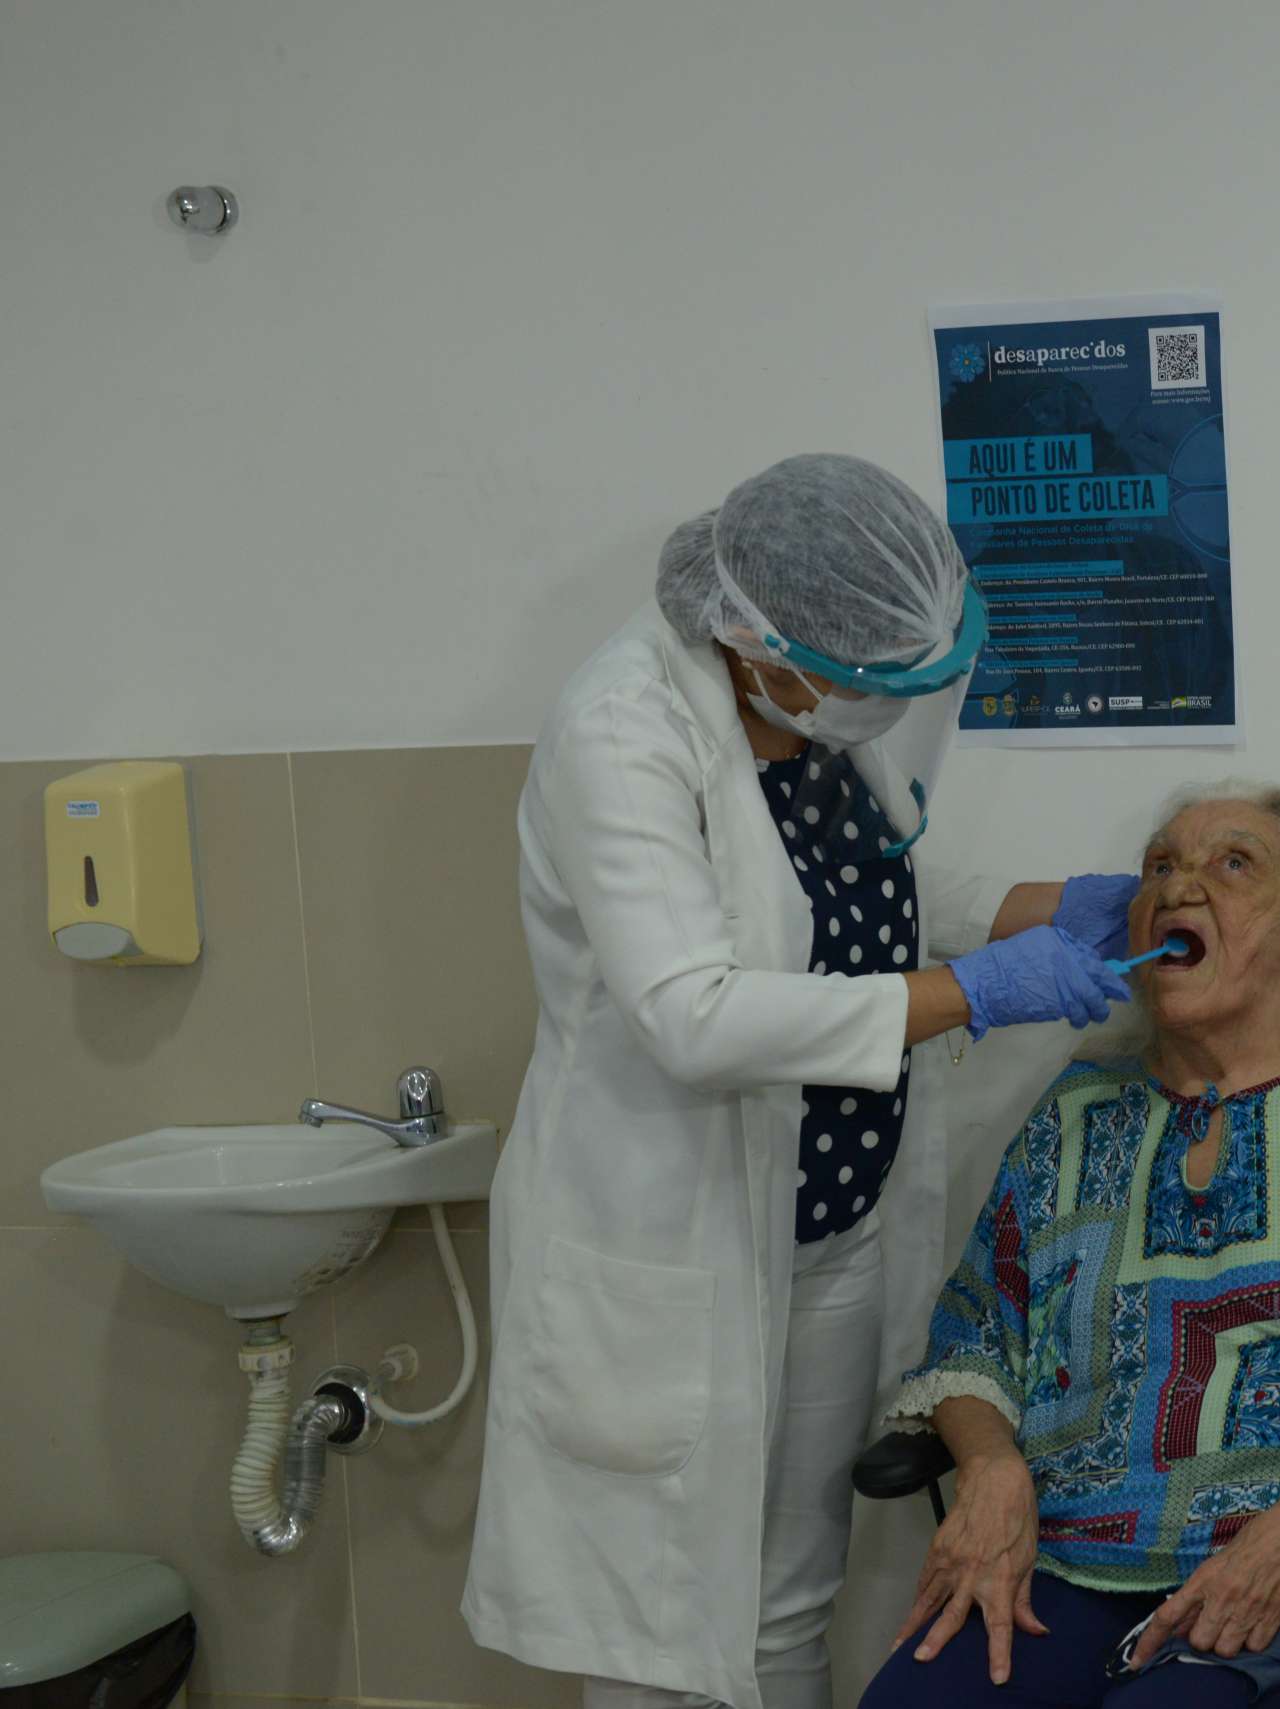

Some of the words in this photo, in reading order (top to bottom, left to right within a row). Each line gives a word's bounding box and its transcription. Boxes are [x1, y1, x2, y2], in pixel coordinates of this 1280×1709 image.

[994, 340, 1126, 367] desaparecdos
[969, 442, 1016, 477] AQUI
[1024, 438, 1036, 472] É
[1044, 440, 1077, 471] UM
[972, 484, 1037, 516] PONTO
[1046, 482, 1072, 514] DE
[1078, 479, 1155, 512] COLETA
[1055, 704, 1081, 713] CEARÁ
